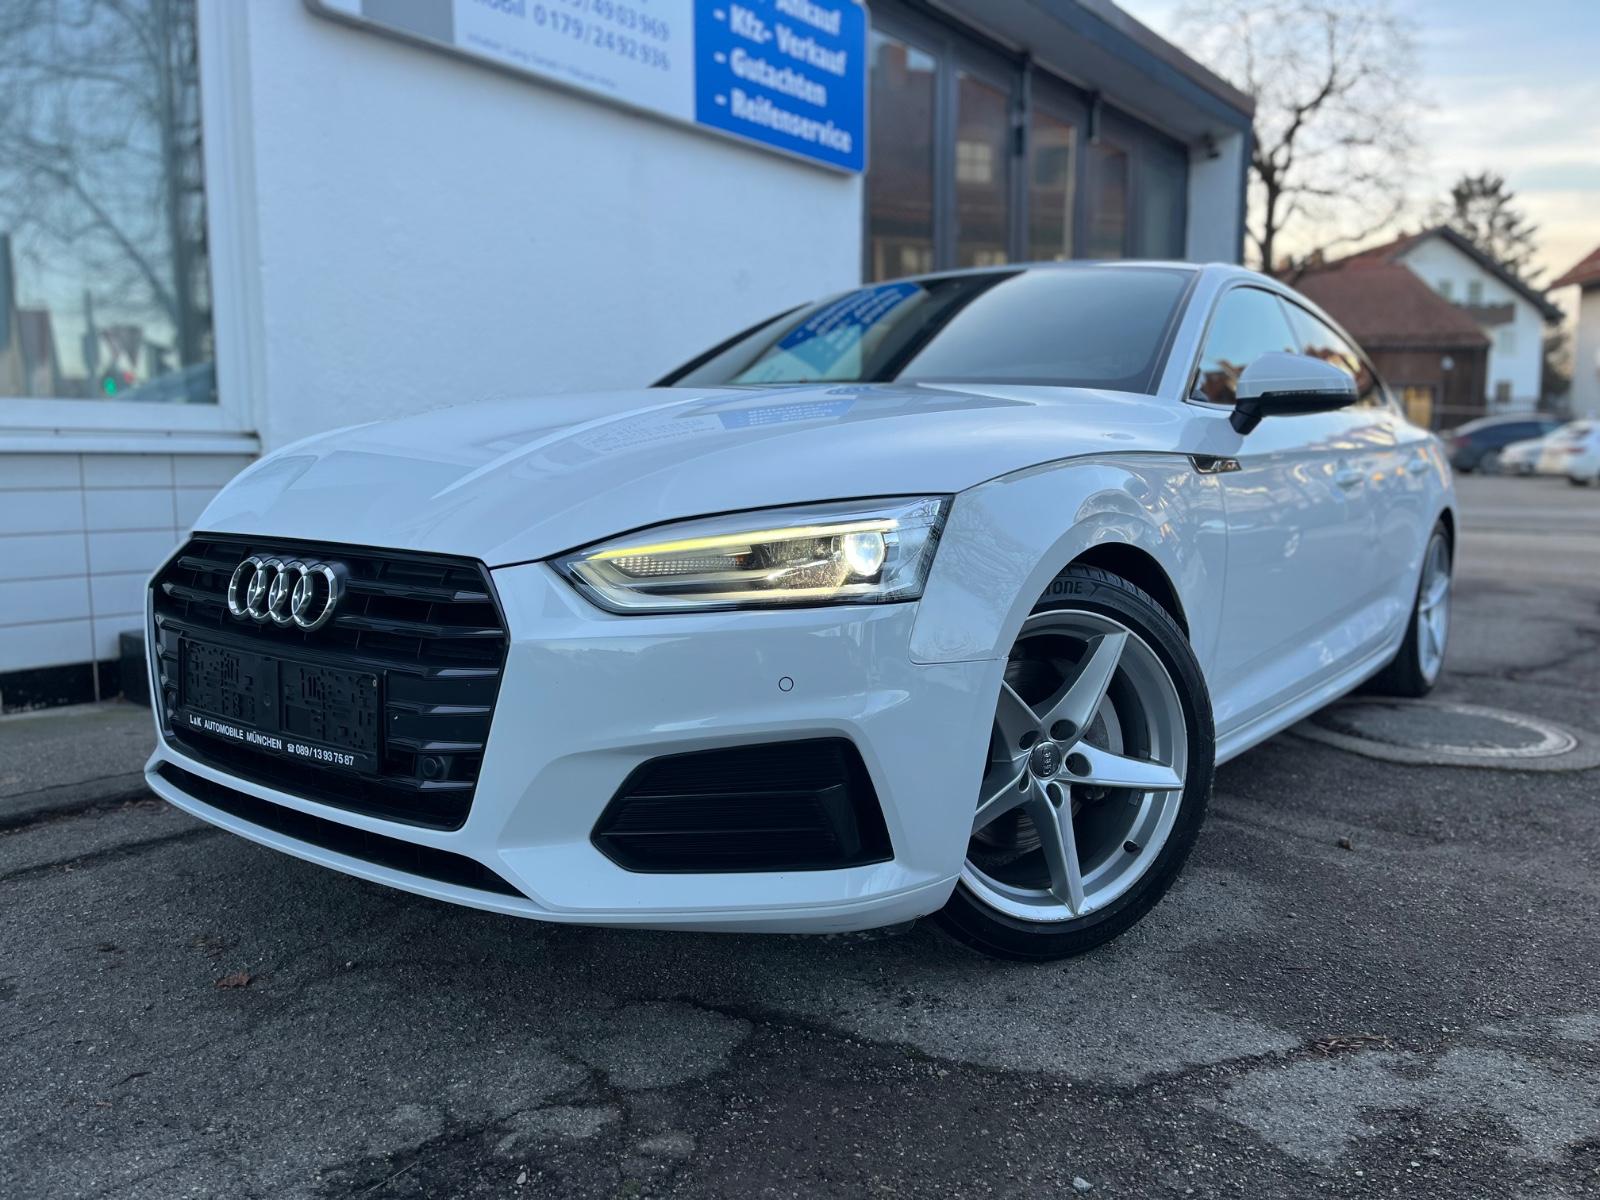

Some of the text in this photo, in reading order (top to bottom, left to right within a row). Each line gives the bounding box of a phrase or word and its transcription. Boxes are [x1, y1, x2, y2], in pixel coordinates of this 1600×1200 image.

[730, 47, 827, 107] Gutachten
[775, 22, 847, 77] Verkauf
[730, 87, 852, 153] Reifenservice
[204, 719, 244, 740] AUTOMOBILE
[246, 731, 282, 749] MÜNCHEN
